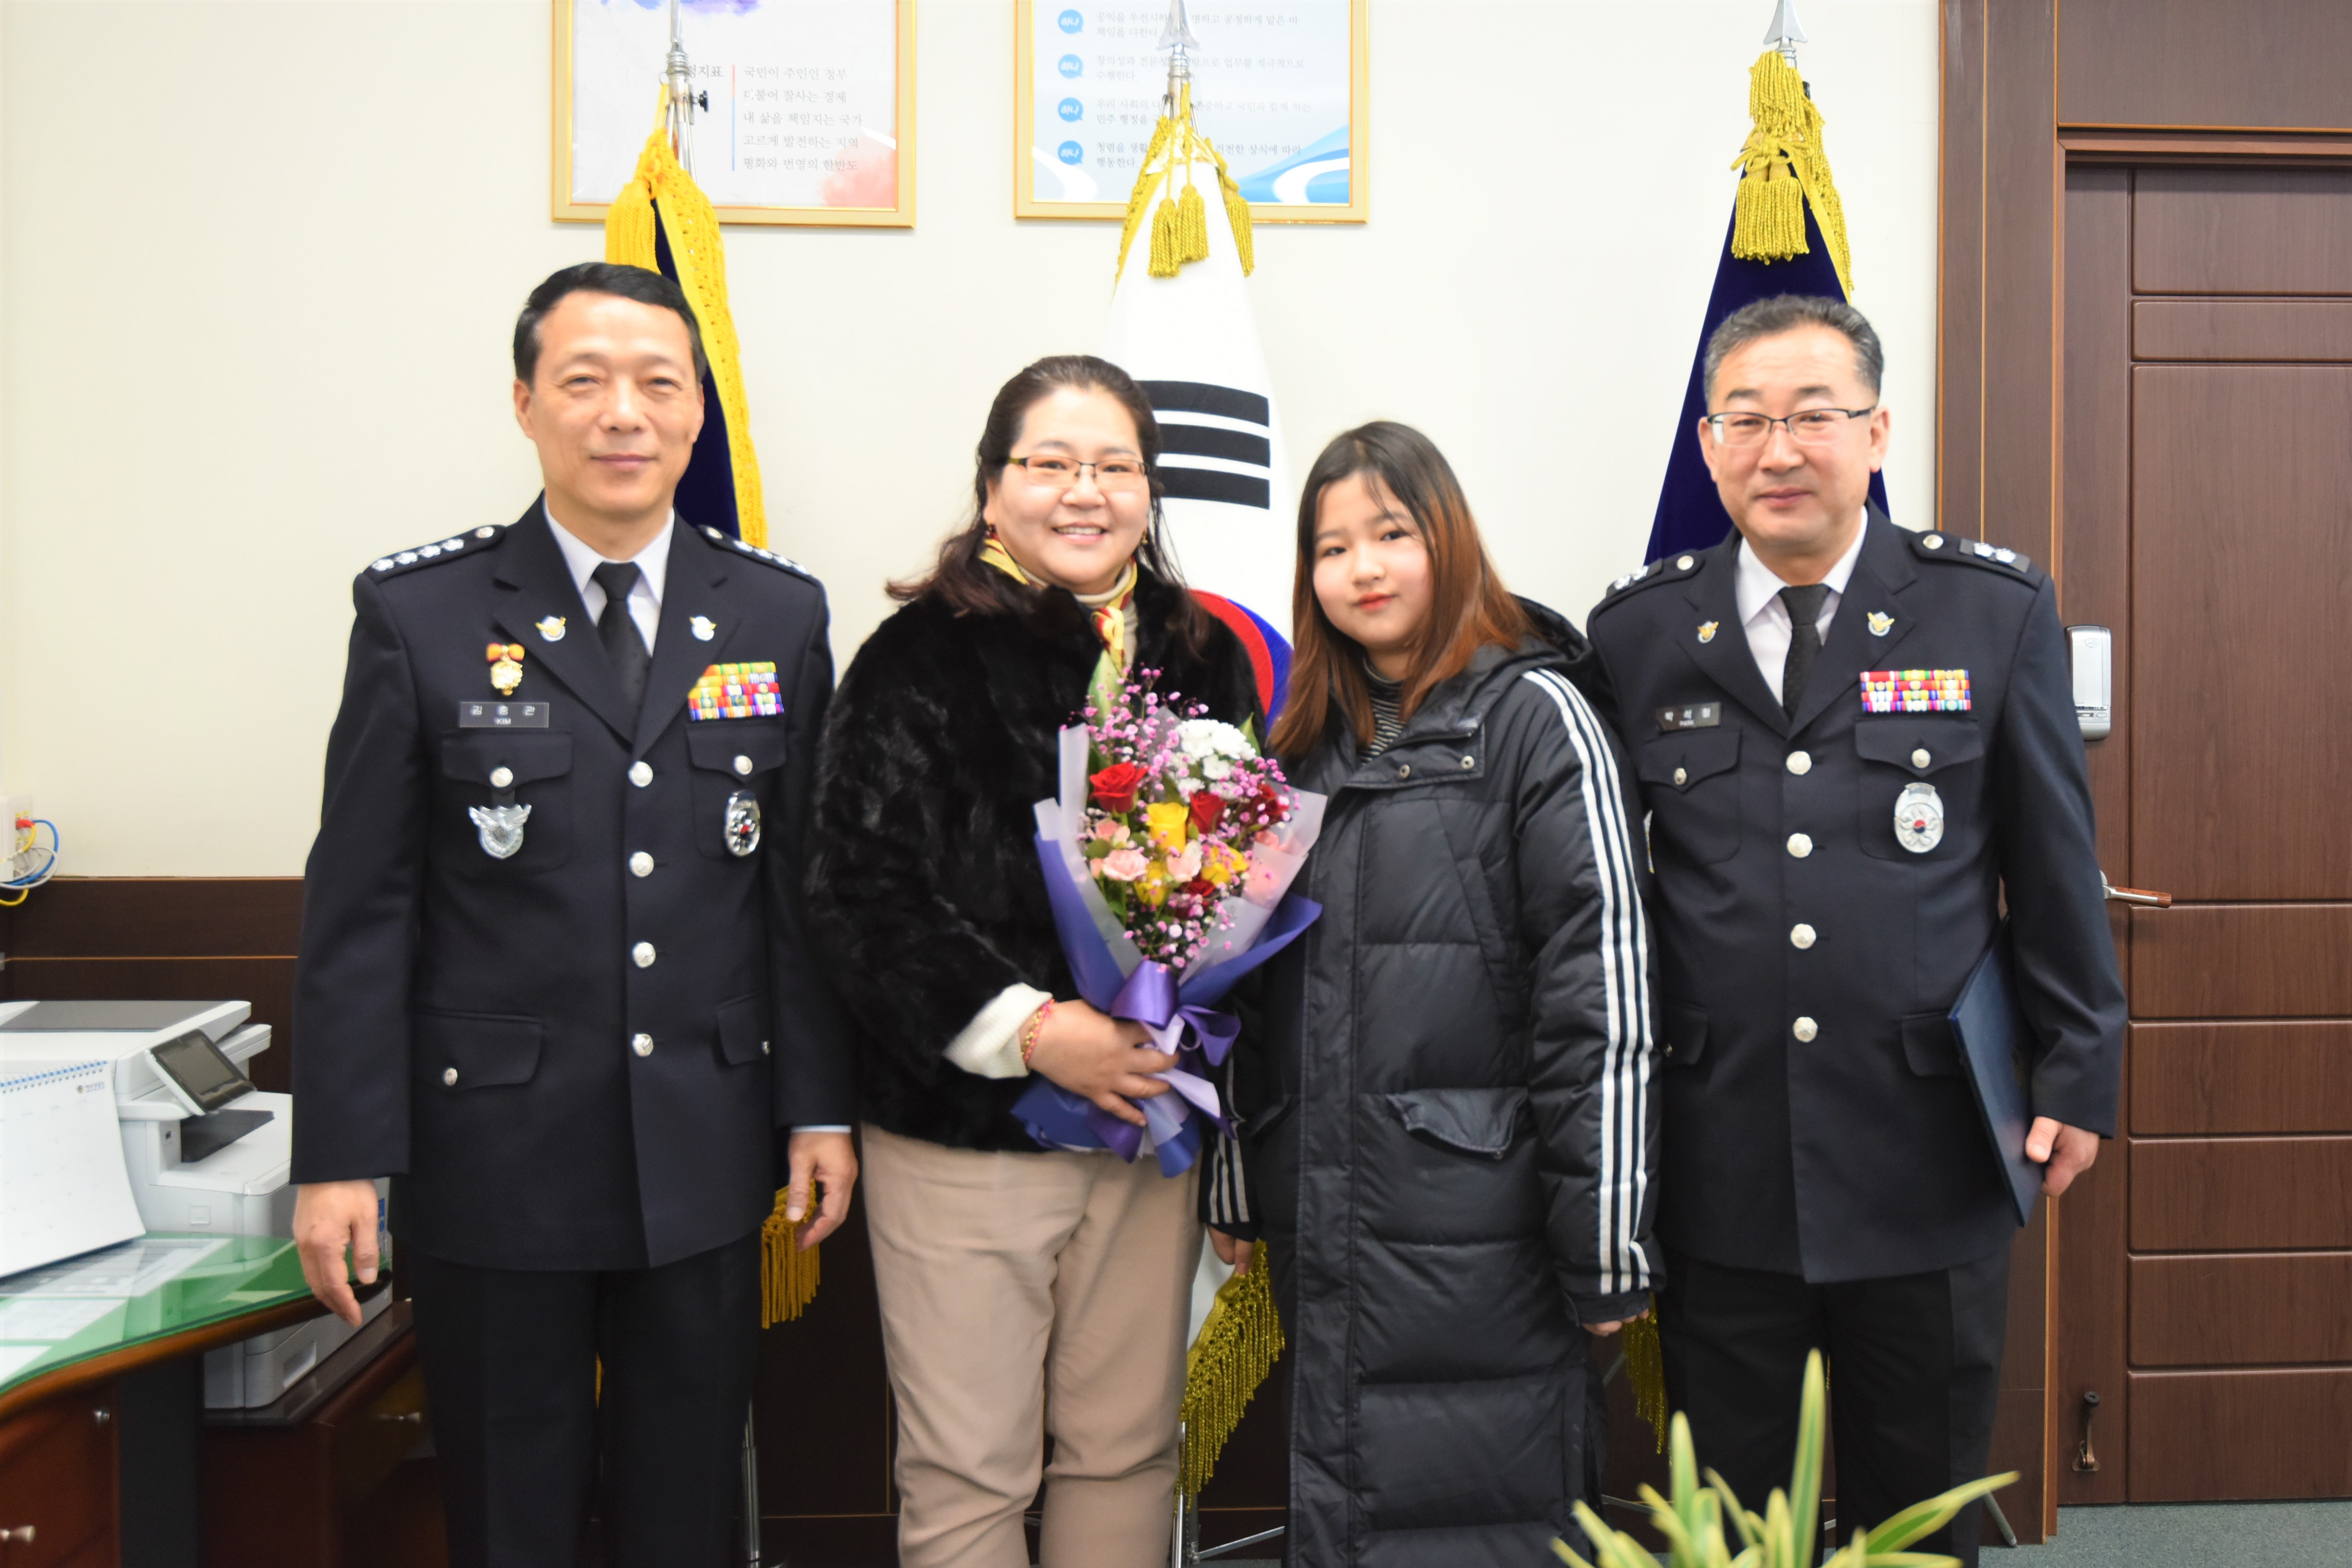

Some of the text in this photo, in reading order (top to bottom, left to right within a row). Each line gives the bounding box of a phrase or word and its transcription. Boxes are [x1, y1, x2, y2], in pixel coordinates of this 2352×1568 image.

[1061, 17, 1079, 26] 하나
[1096, 12, 1125, 23] 공익을
[1129, 12, 1169, 24] 우선시하
[1192, 14, 1220, 25] 명하고
[1224, 14, 1263, 25] 공정하게
[1096, 27, 1125, 37] 책임을
[1061, 62, 1079, 71] 하나
[1140, 56, 1169, 67] 전문성
[688, 64, 724, 79] 정지표
[743, 66, 848, 81] 국민이 주인인 정부
[744, 89, 847, 103] 더불어 잘사는 경제
[1061, 105, 1079, 114] 하나
[1096, 99, 1115, 110] 우리
[744, 111, 863, 127] 내 삶을 책임지는 국가
[1096, 113, 1116, 124] 민주
[744, 135, 859, 149] 고르게 발전하는 지역
[1061, 148, 1079, 158] 하나
[1097, 142, 1125, 153] 청렴을
[1248, 144, 1278, 156] 상식에
[1282, 145, 1301, 156] 따라
[743, 157, 859, 171] 평화와 번영의 한반도
[1096, 157, 1139, 168] 행동한다.
